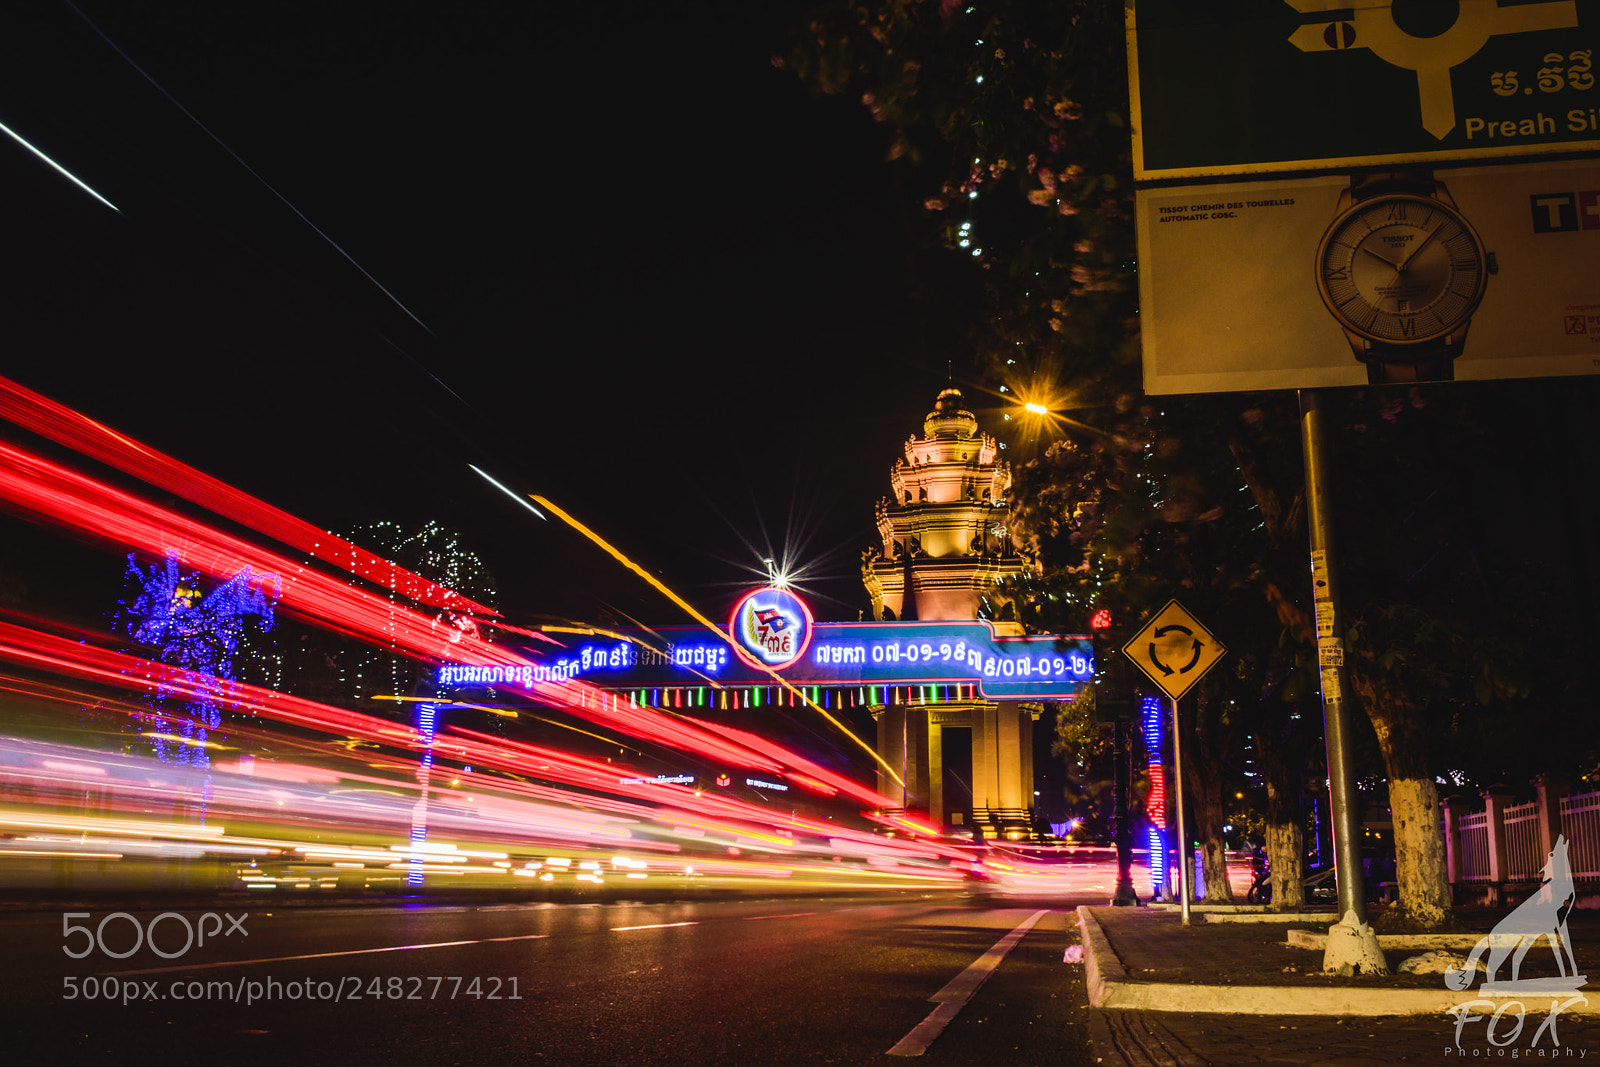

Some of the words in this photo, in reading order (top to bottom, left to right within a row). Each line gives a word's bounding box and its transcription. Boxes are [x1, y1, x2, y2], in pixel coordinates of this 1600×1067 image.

[1465, 112, 1556, 140] Preah
[1567, 108, 1600, 132] Si
[1159, 205, 1188, 214] TISSOT
[1190, 203, 1225, 212] CHEMIN
[1245, 198, 1295, 208] TOURELLES
[1159, 213, 1209, 223] AUTOMATIC
[1211, 211, 1238, 220] COSC.
